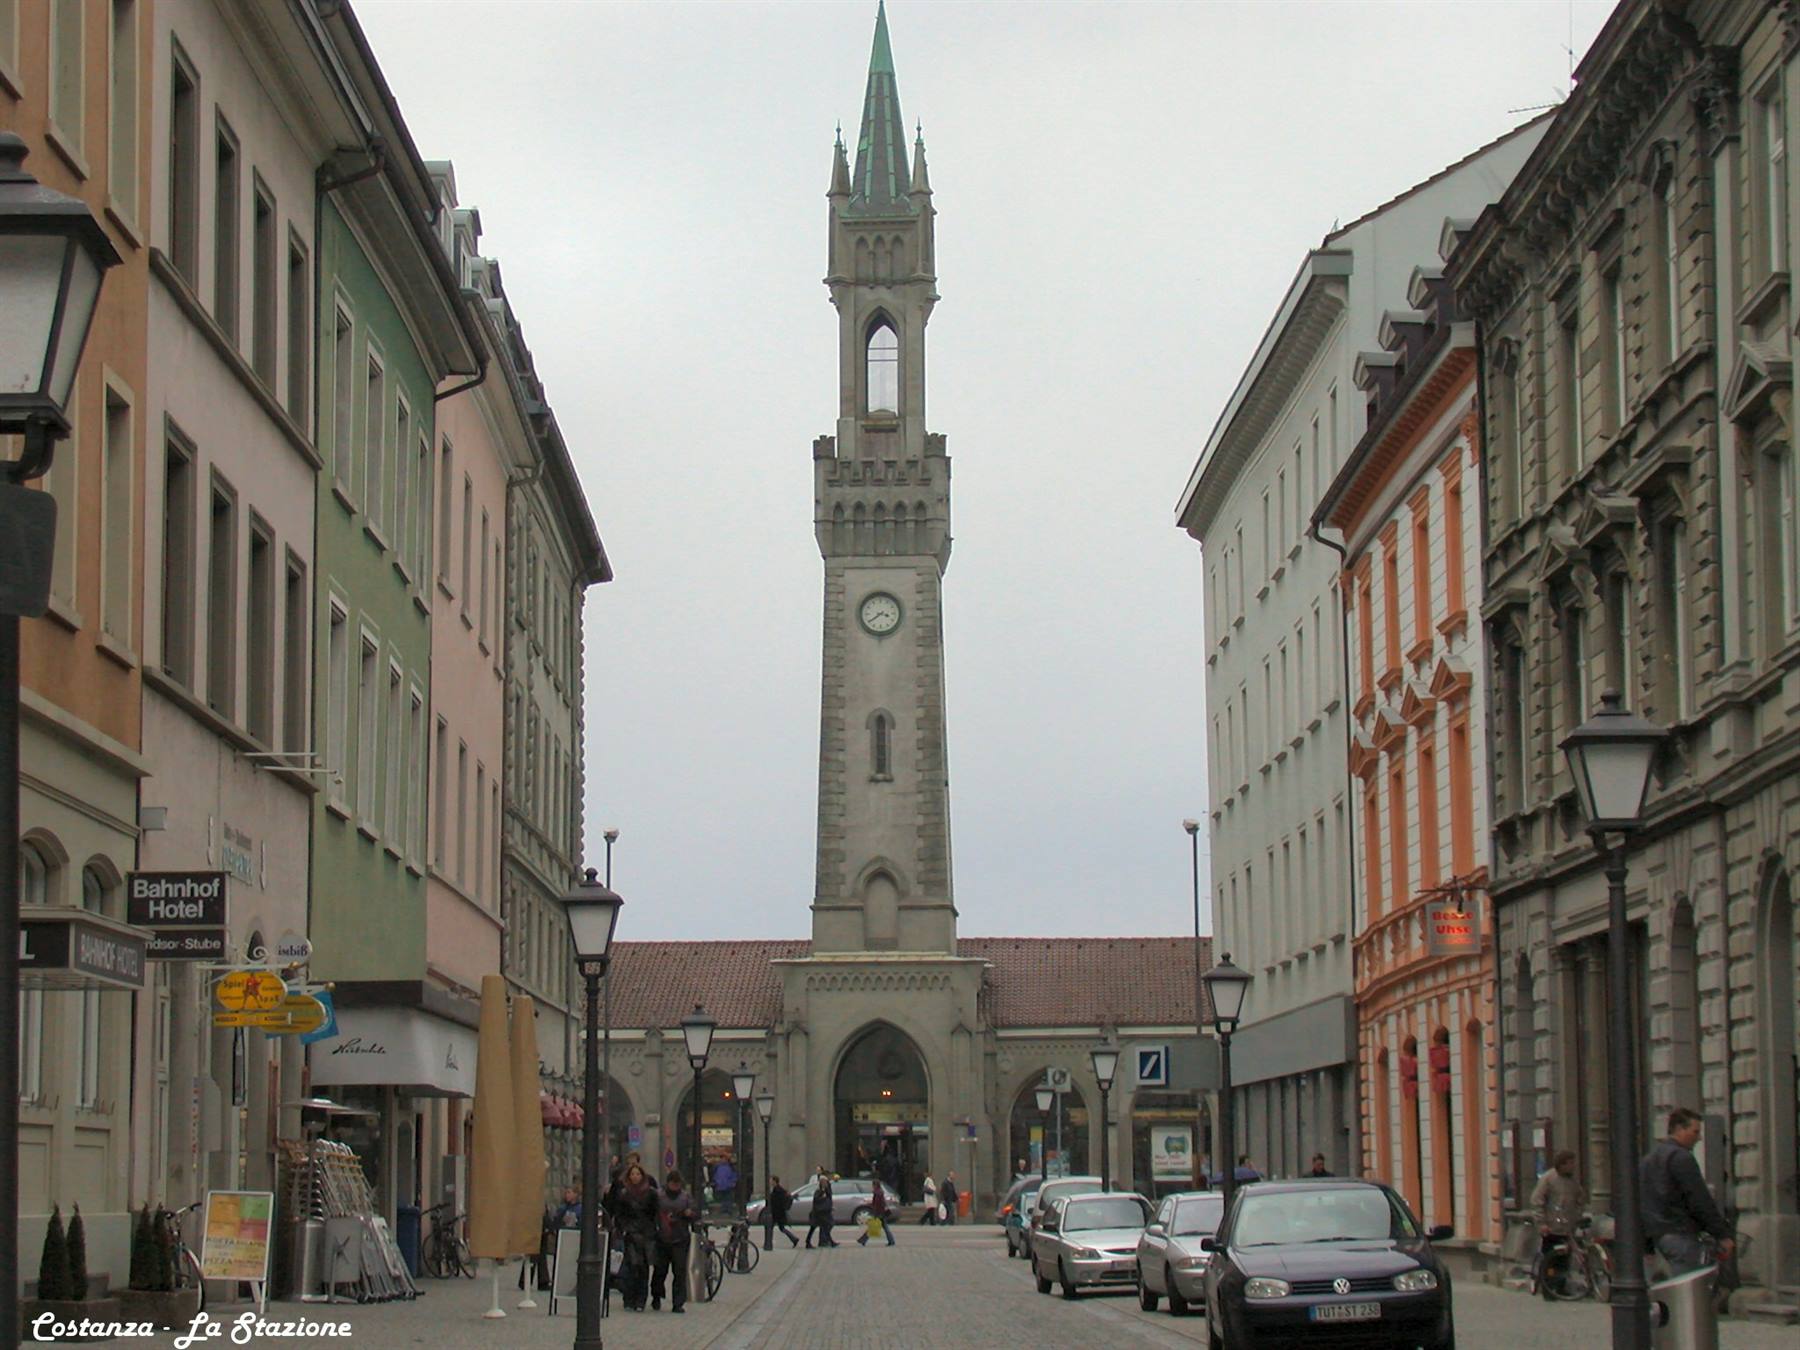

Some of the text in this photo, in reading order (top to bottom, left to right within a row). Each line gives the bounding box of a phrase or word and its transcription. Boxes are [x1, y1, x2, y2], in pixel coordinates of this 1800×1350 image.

[133, 879, 220, 898] Bahnhof
[149, 900, 204, 919] Hotel
[145, 938, 222, 950] ndsor-Stube
